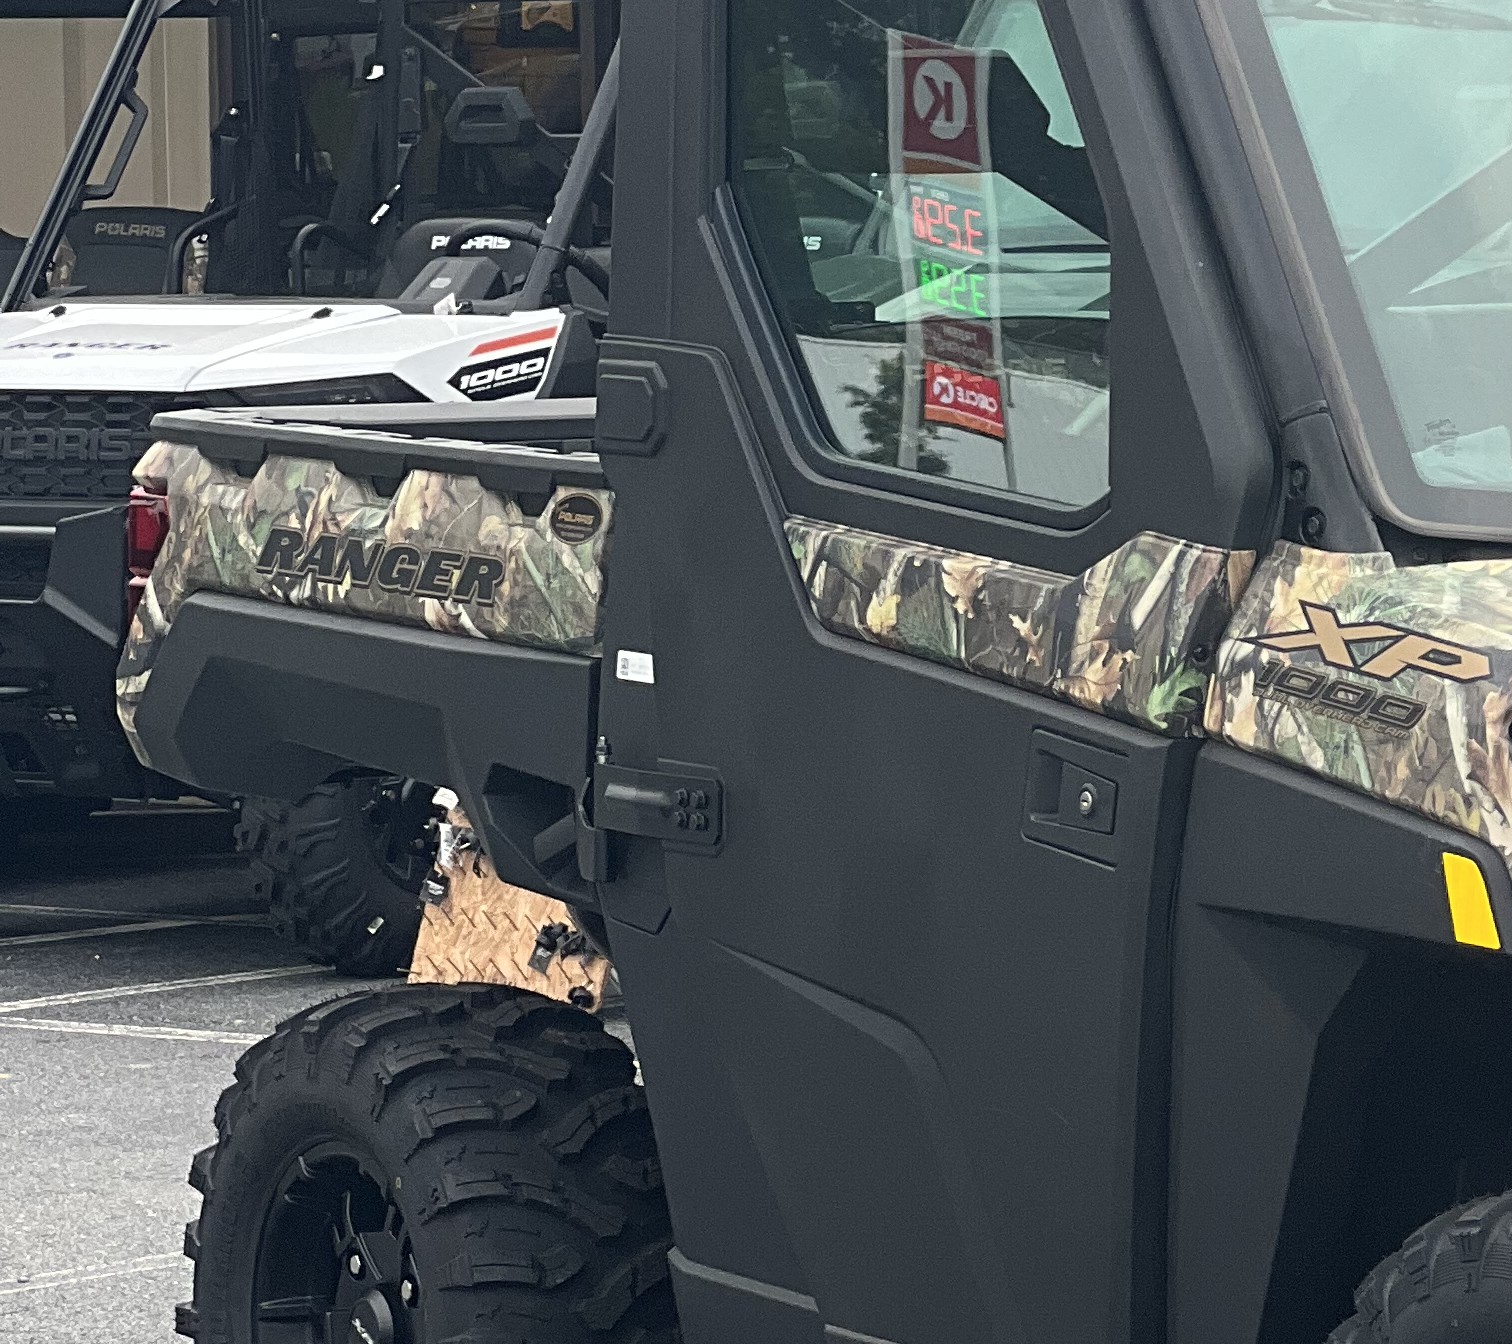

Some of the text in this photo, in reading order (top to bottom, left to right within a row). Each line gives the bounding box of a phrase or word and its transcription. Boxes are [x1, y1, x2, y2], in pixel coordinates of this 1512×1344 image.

[95, 222, 166, 238] POLARIS
[431, 235, 511, 250] PARIS
[460, 357, 545, 390] 1000
[0, 427, 131, 461] LARIS
[255, 525, 505, 606] RANGER
[1236, 599, 1494, 683] XP
[1255, 658, 1427, 731] 1000
[1375, 724, 1410, 740] CAM
